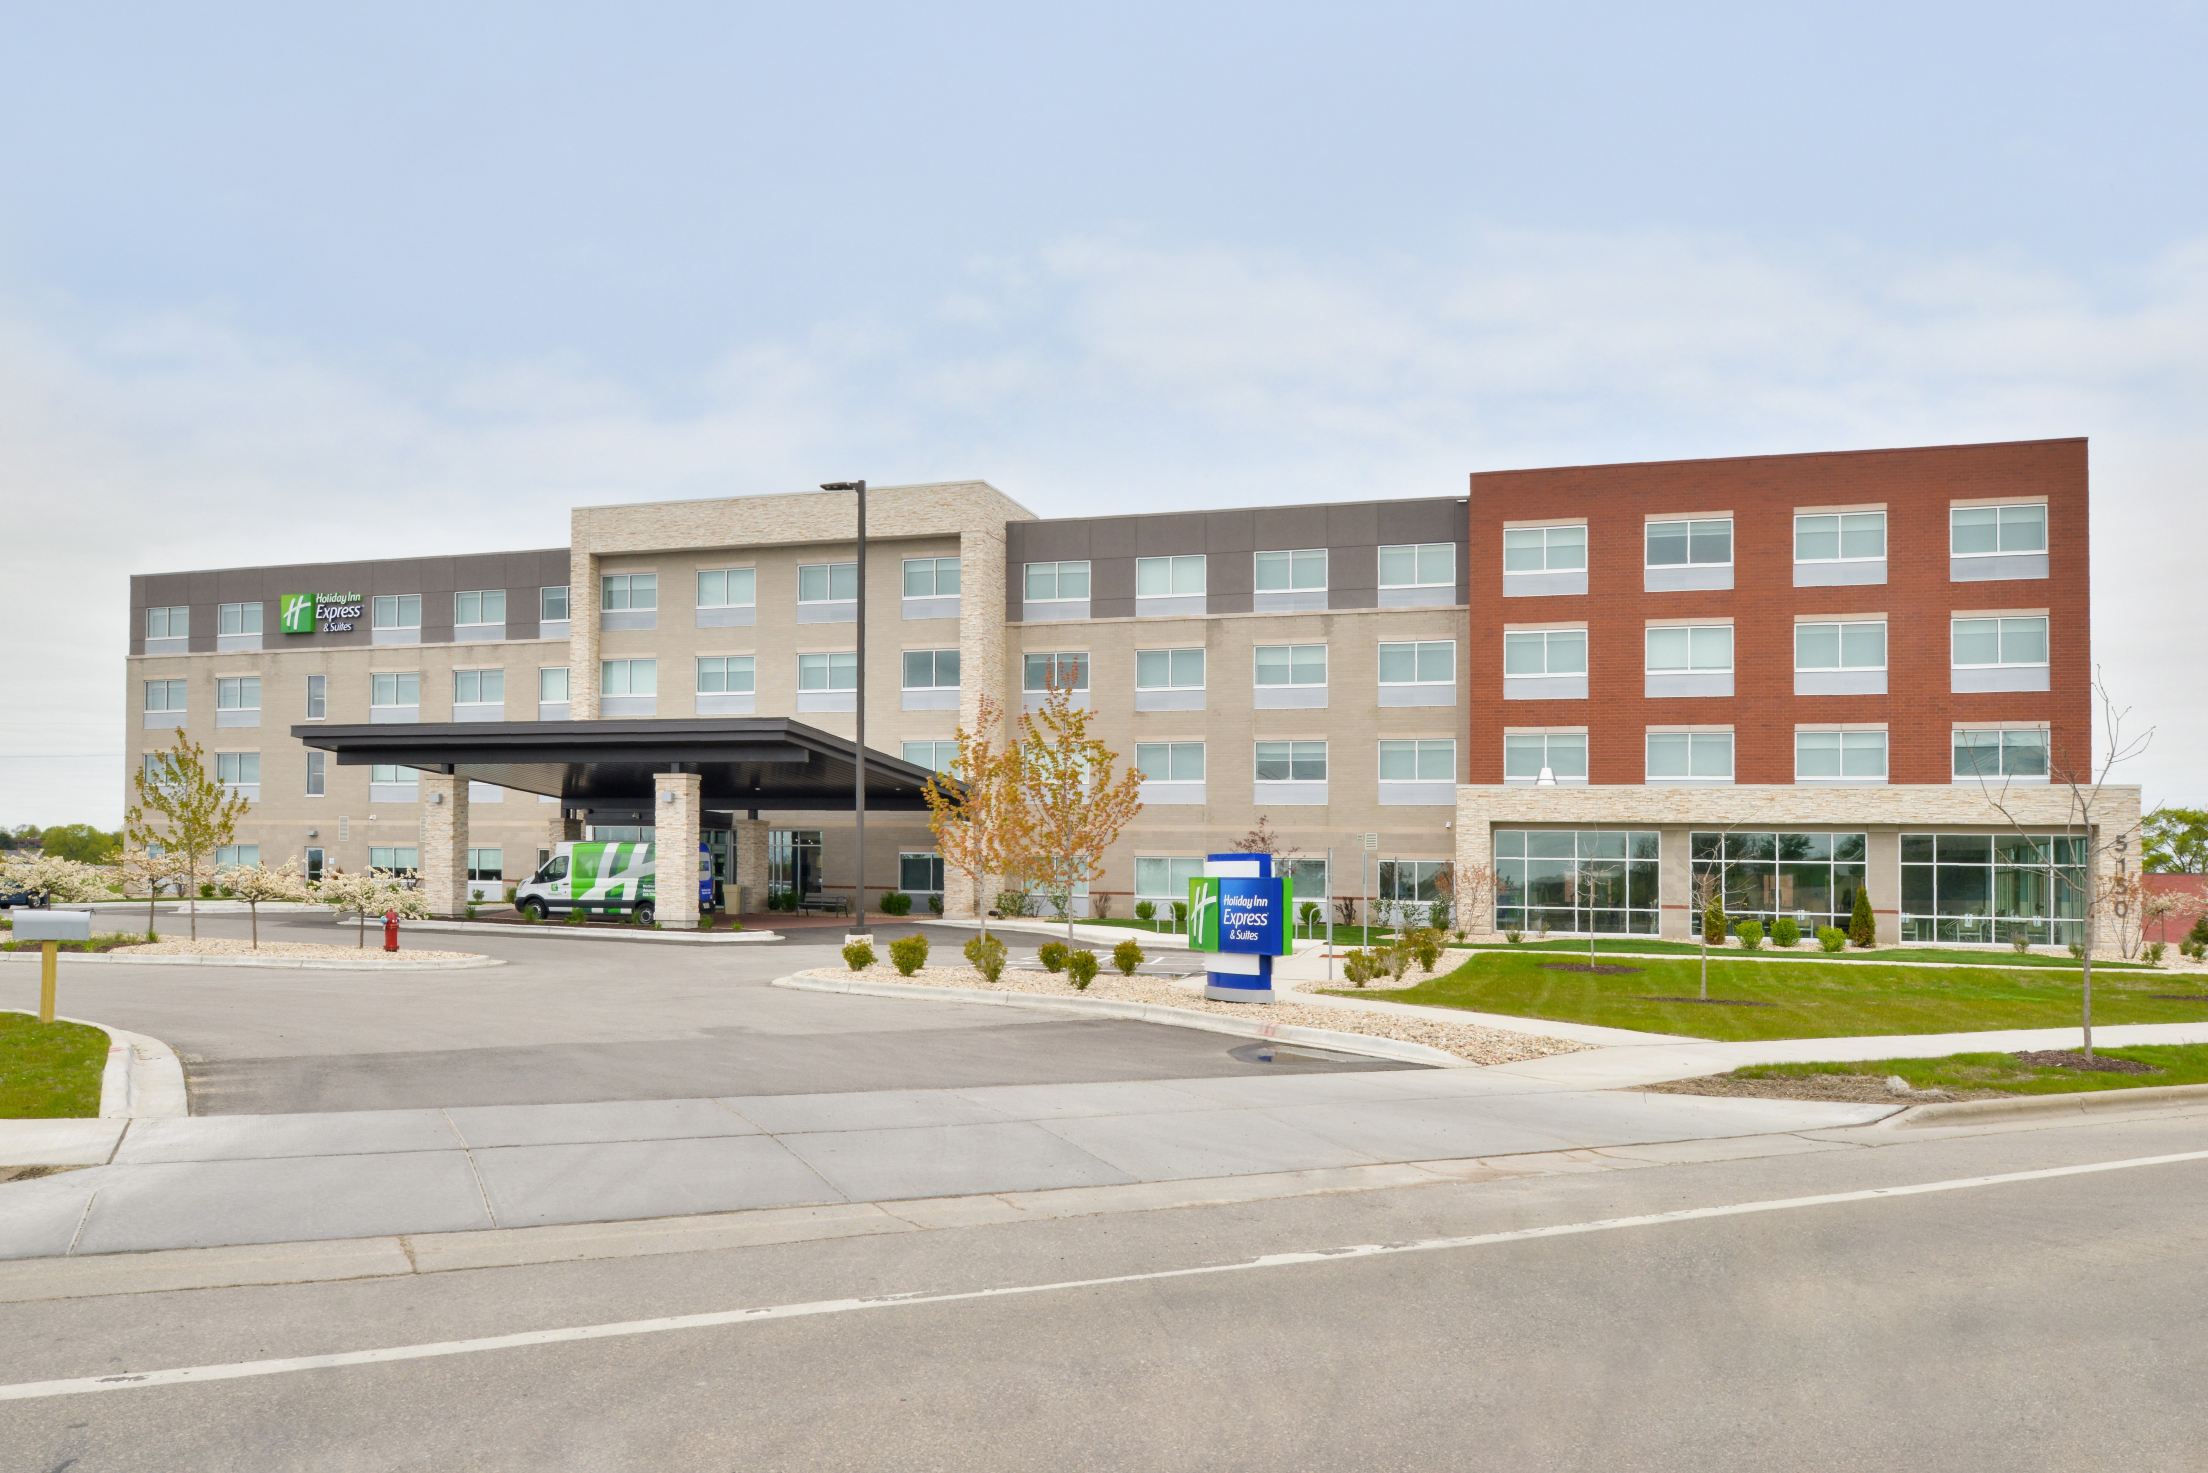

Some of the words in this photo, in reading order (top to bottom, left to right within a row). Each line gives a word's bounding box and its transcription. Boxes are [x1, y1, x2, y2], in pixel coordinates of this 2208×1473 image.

[316, 592, 347, 604] Holiday
[348, 591, 360, 601] Inn
[316, 604, 361, 622] Express
[323, 623, 329, 632] &
[330, 622, 352, 632] Suites
[1224, 895, 1252, 909] Holiday
[1253, 895, 1267, 906] Inn
[1224, 909, 1267, 928] Express
[1230, 930, 1235, 940] &
[1236, 930, 1258, 940] Suites
